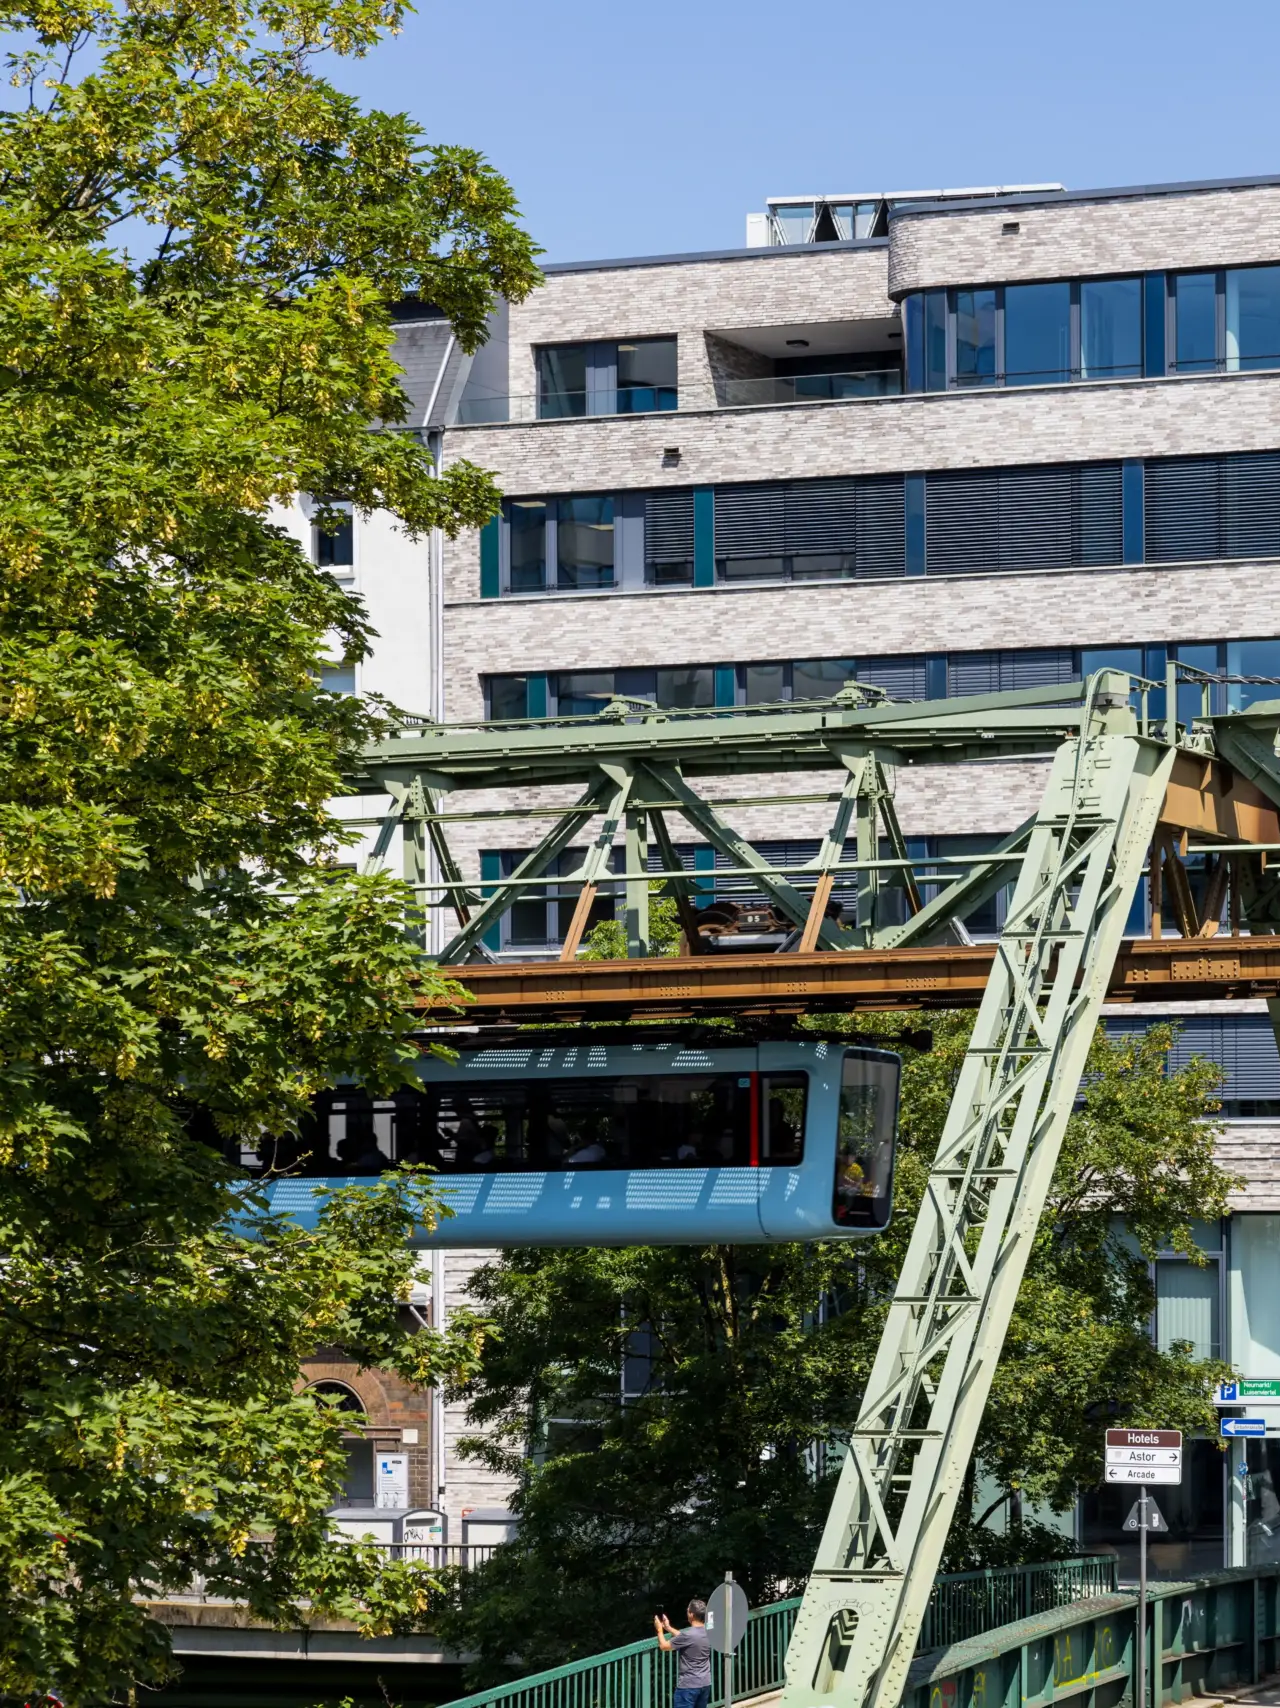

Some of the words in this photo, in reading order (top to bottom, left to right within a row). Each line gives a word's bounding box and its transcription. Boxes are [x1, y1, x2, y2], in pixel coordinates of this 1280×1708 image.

[1127, 1433, 1160, 1444] Hotels
[1129, 1451, 1156, 1461] Astor
[1127, 1470, 1155, 1479] Arcade
